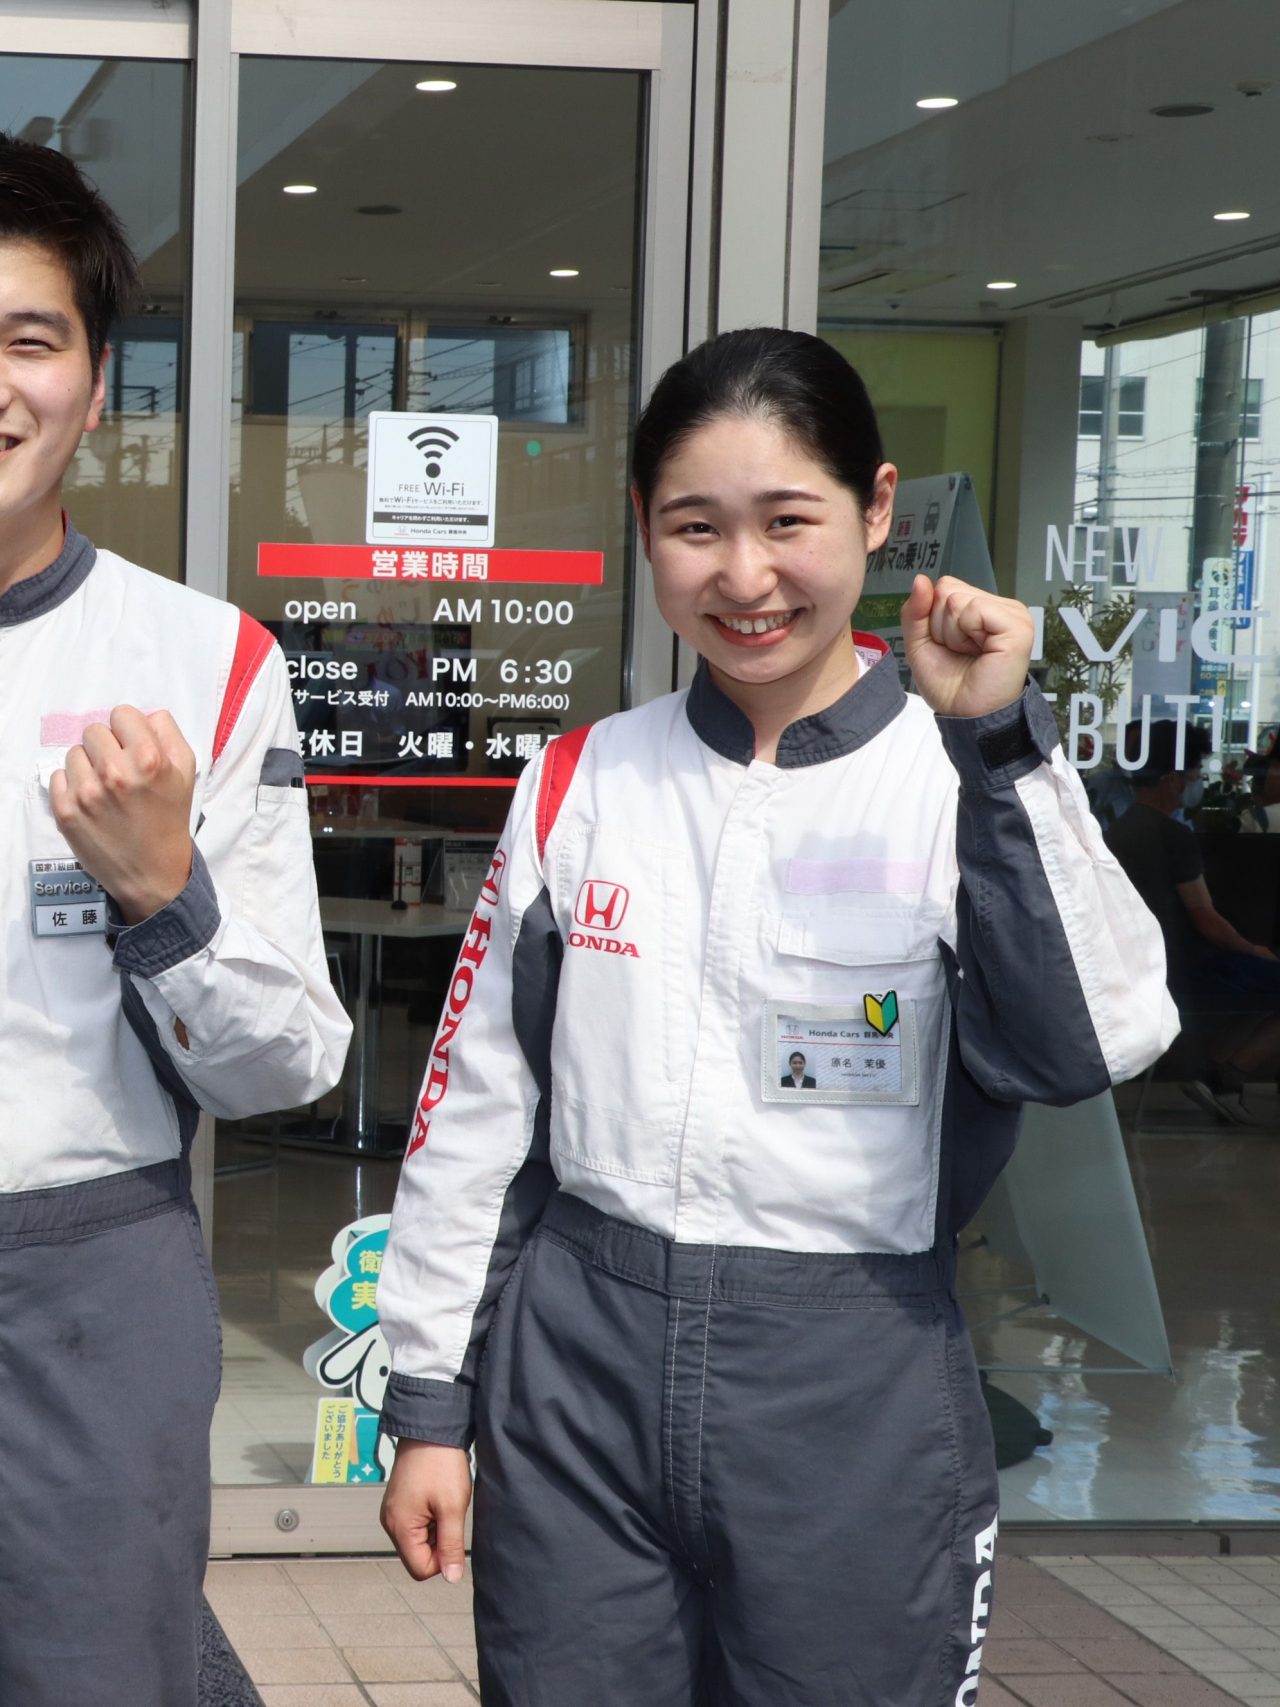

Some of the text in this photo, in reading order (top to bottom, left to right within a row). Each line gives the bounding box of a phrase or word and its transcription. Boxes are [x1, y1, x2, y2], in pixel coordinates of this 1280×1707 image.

[398, 481, 465, 497] FREE Wi-Fi
[372, 550, 489, 580] 営業時間
[1045, 524, 1165, 583] NEW
[284, 598, 574, 625] open AM 10:00
[286, 655, 573, 684] close PM 6:30
[290, 689, 390, 708] サービス受付
[397, 731, 563, 760] 火曜・水曜
[1042, 692, 1225, 775] BUT!
[34, 880, 91, 896] Service
[52, 909, 97, 927] 佐 藤
[567, 932, 640, 958] ONDA
[406, 911, 491, 1162] HONDA
[809, 1029, 837, 1038] Honda
